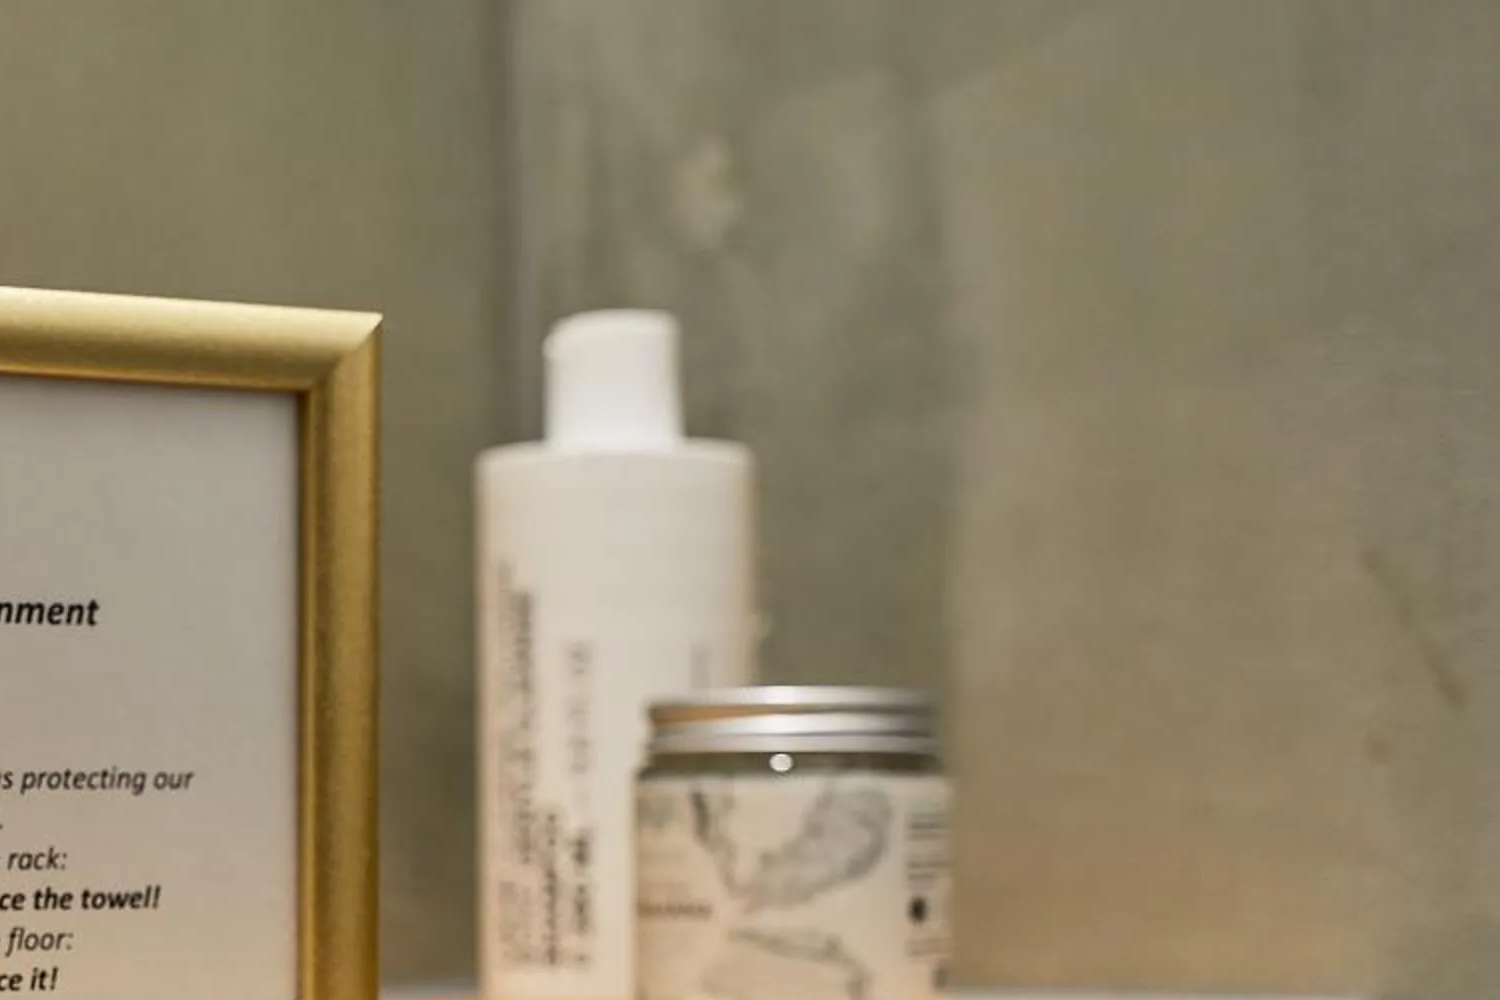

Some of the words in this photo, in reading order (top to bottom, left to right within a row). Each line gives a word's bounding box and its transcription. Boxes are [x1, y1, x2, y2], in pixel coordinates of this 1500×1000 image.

[19, 767, 147, 797] protecting
[153, 771, 194, 790] our
[7, 847, 68, 871] rack:
[33, 885, 74, 911] the
[80, 884, 162, 911] towel!
[5, 926, 73, 958] floor:
[29, 966, 59, 991] it!
